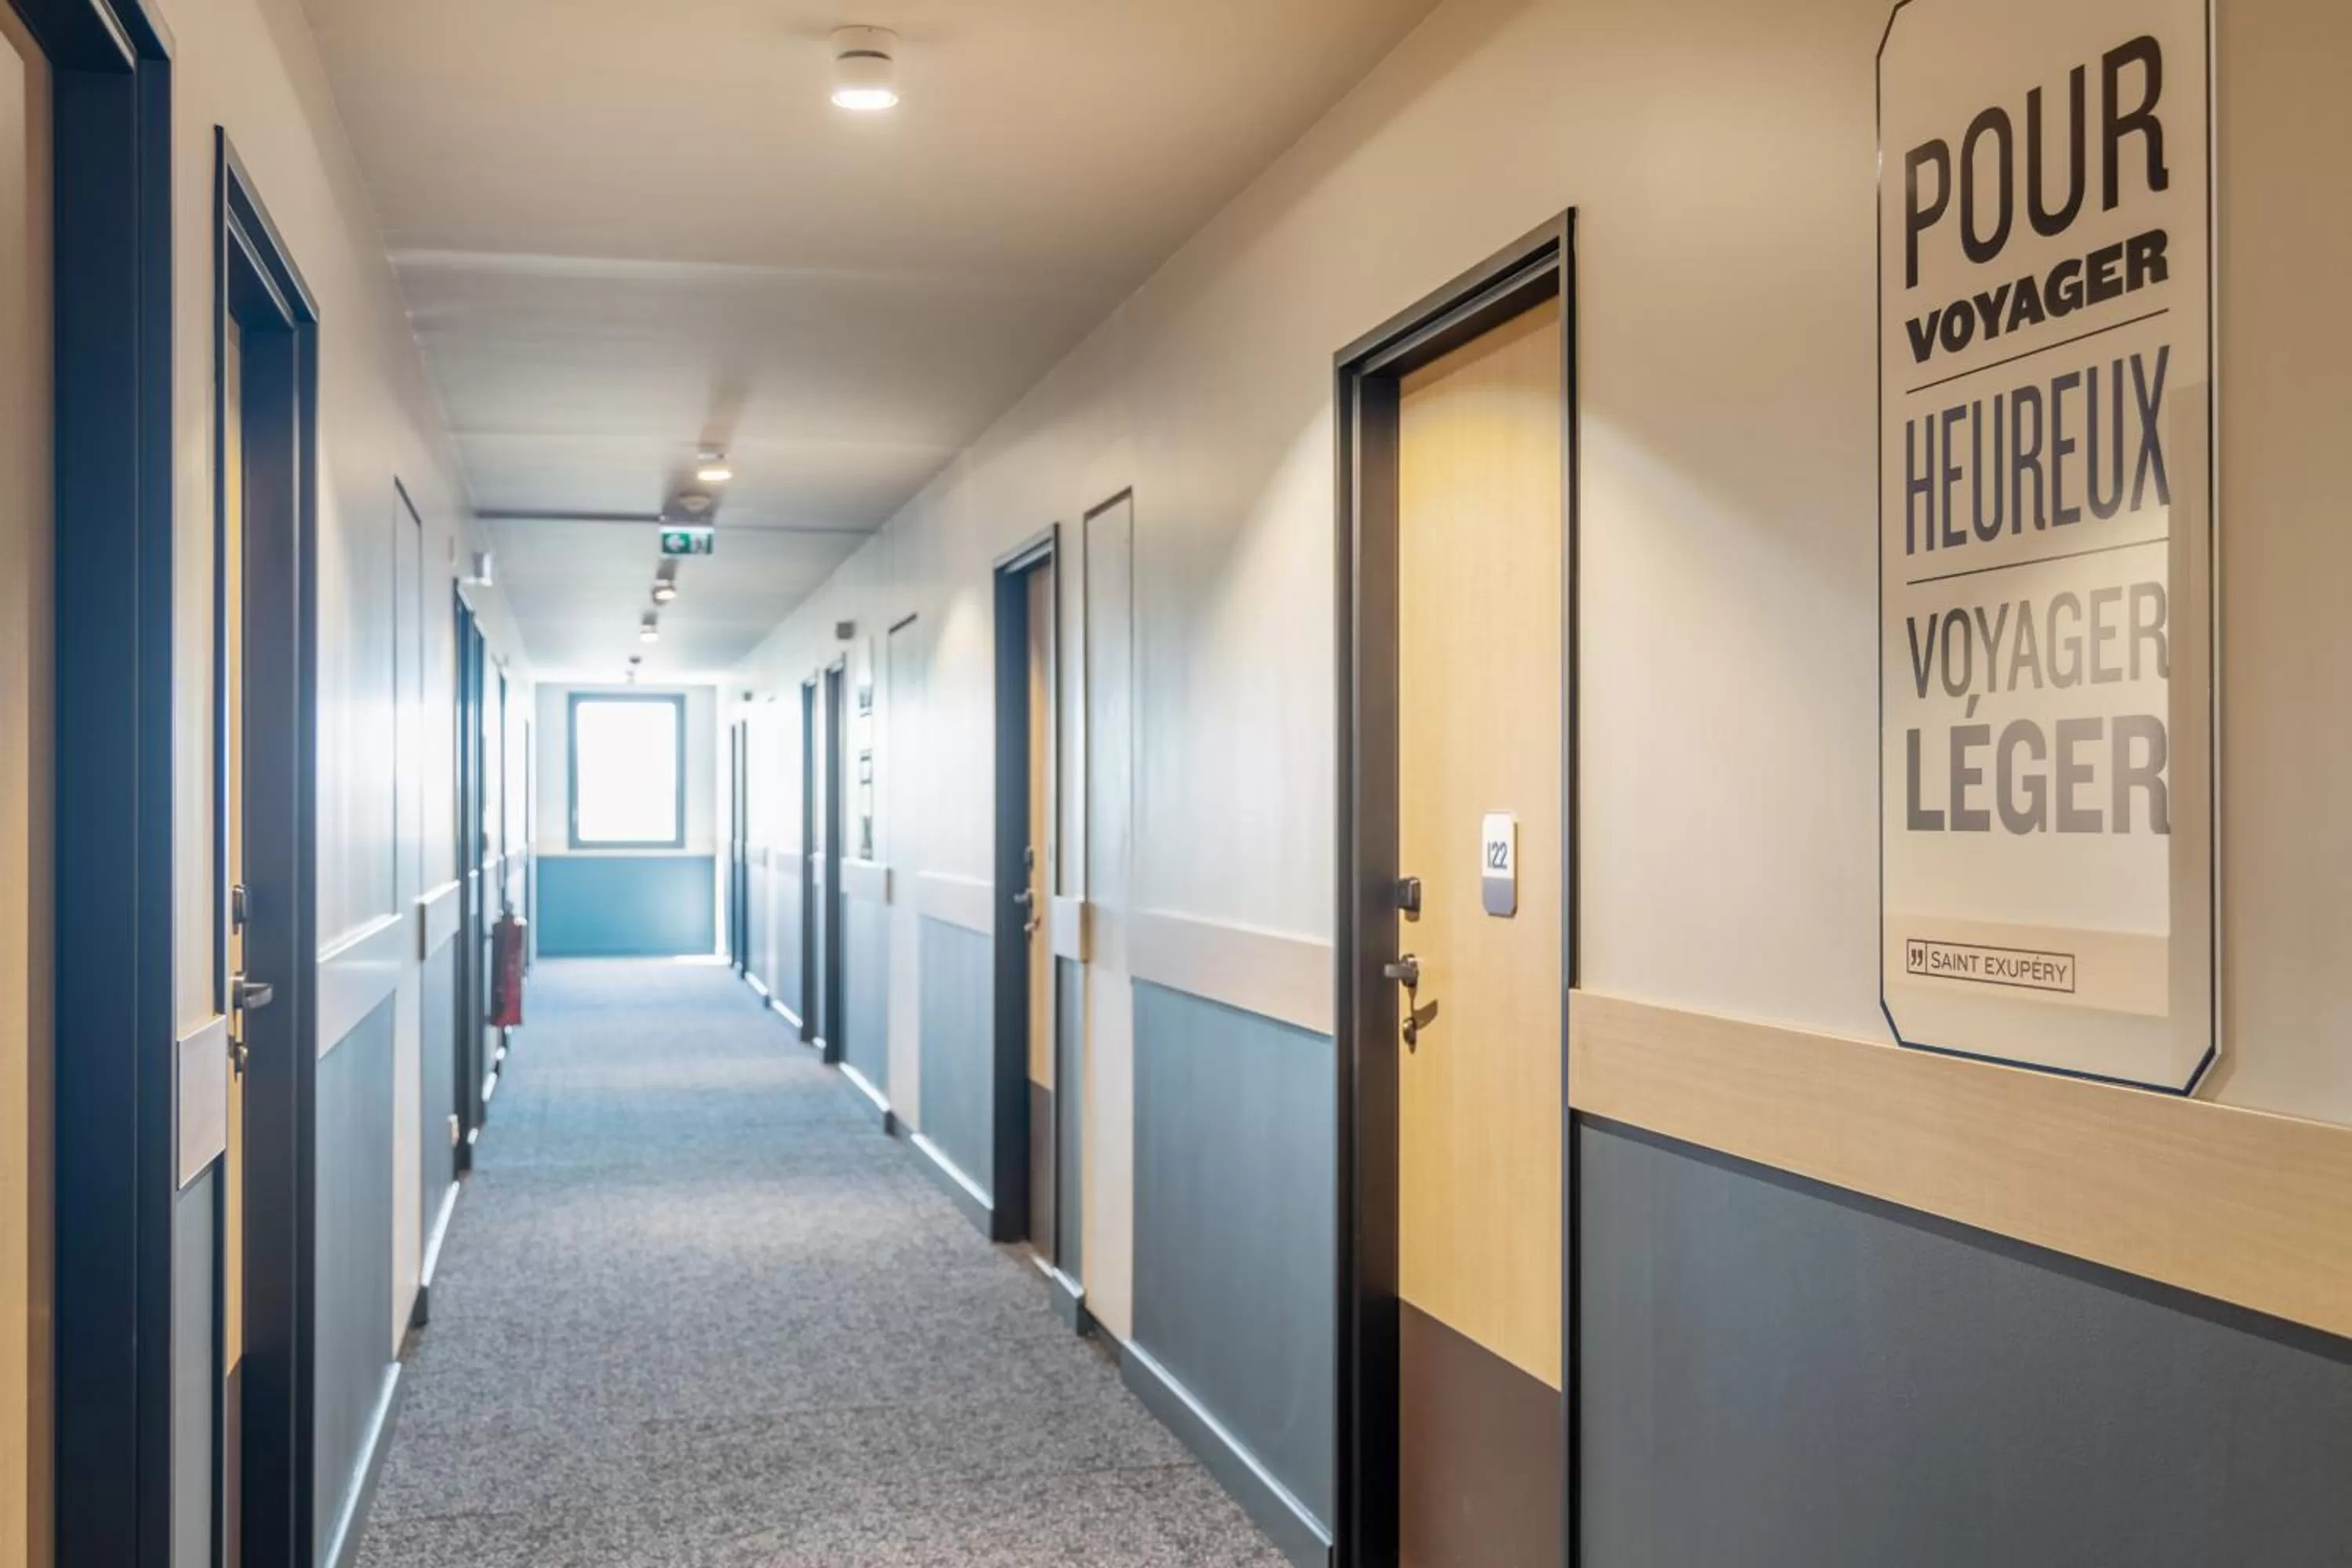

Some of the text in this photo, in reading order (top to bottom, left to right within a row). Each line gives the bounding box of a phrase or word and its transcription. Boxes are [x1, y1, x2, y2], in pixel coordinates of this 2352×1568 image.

[1905, 35, 2169, 289] POUR
[1905, 228, 2169, 364] VOYAGER
[1906, 344, 2170, 555] HEUREUX
[1906, 581, 2169, 699] VOYAGER
[1907, 695, 2170, 836] LÉGER
[1487, 840, 1508, 869] 122
[1931, 951, 2067, 983] SAINT EXUPÉRY
